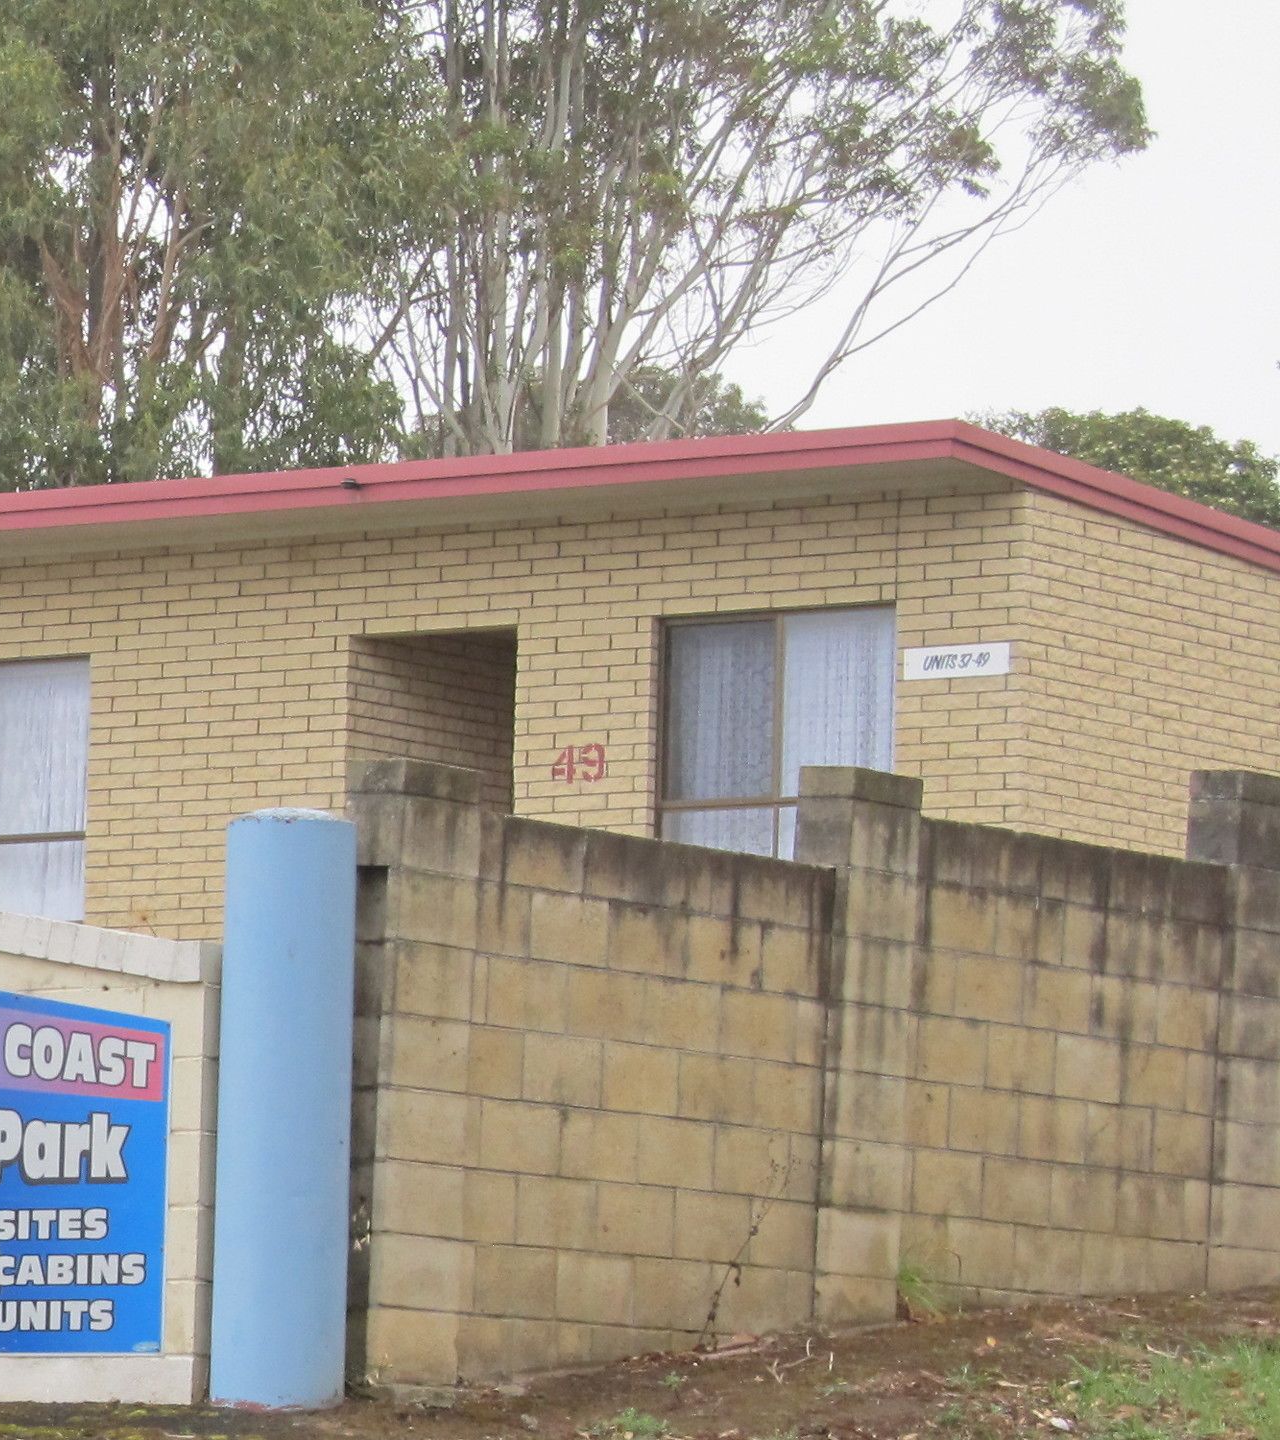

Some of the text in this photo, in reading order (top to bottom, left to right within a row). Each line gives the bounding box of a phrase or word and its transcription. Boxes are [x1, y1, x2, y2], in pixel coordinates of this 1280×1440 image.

[922, 651, 991, 671] UNITS 37-49
[551, 743, 606, 784] 49
[3, 1021, 157, 1089] COAST
